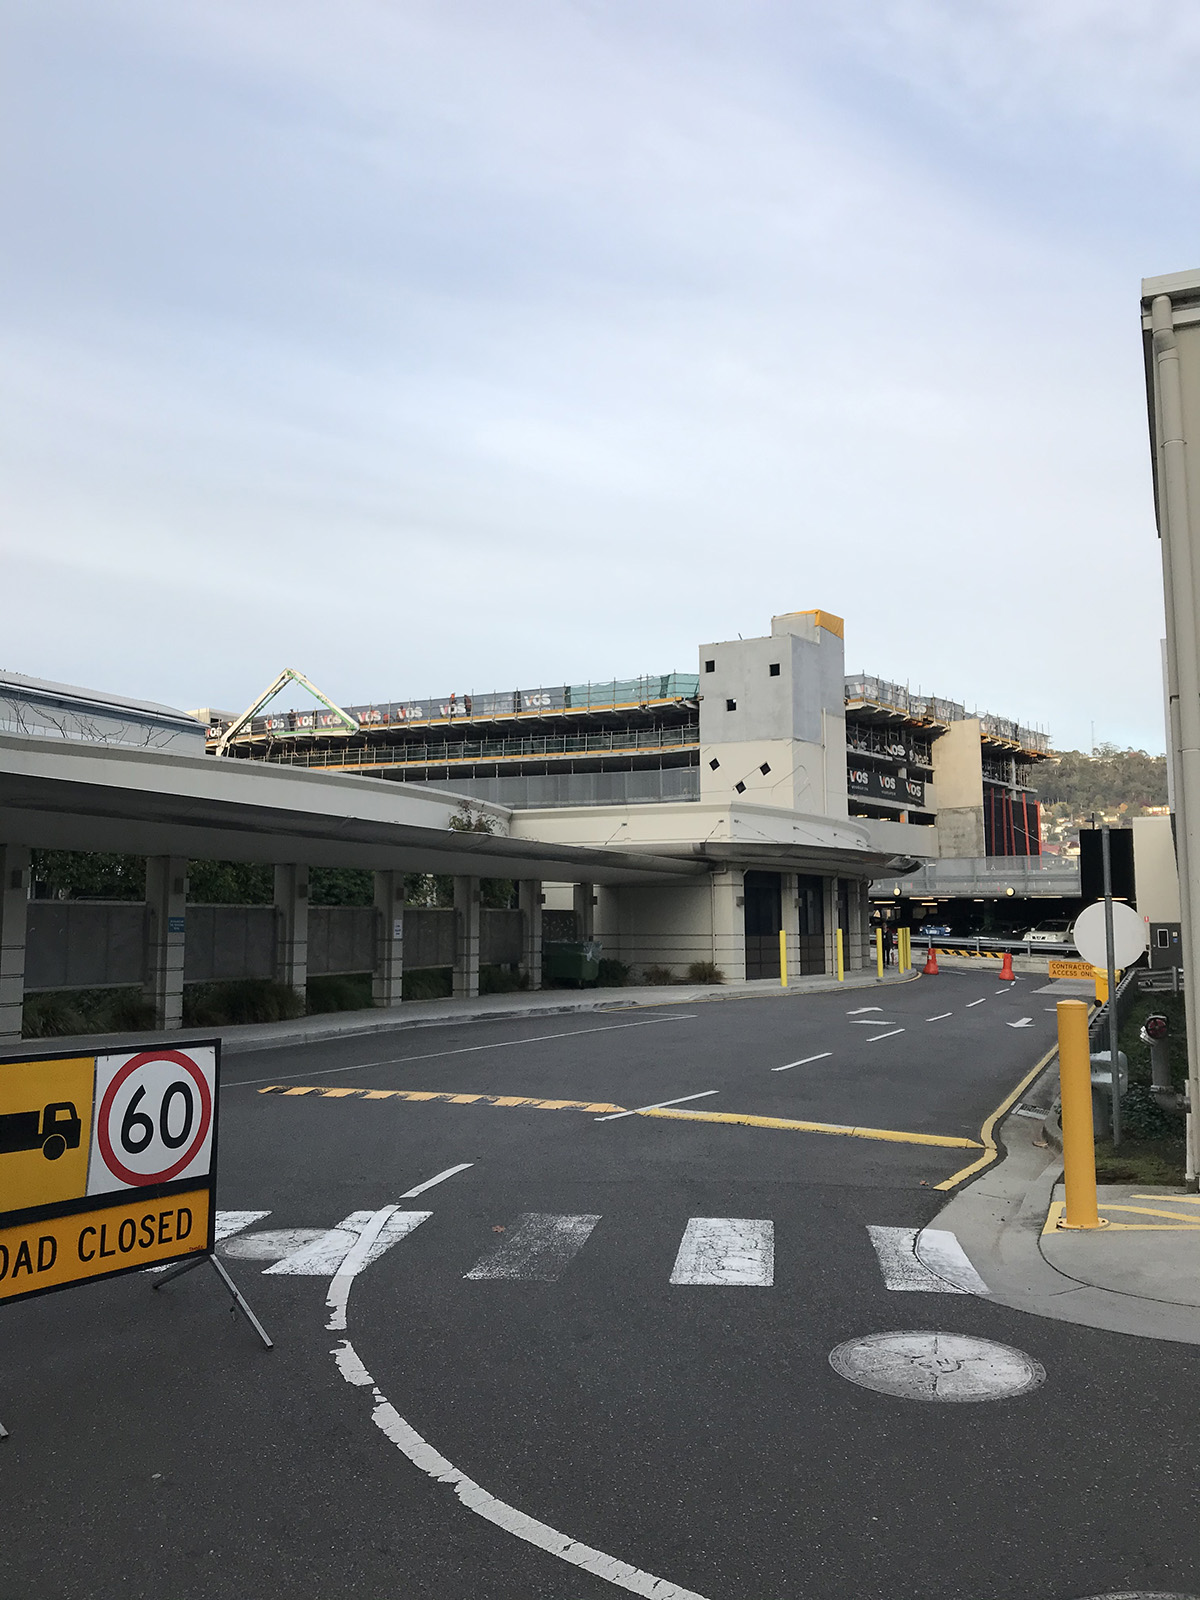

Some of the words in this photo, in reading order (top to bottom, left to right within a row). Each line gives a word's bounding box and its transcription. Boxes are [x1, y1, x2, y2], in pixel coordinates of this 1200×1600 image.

[523, 693, 551, 706] VOS
[397, 706, 423, 719] VOS
[439, 702, 466, 715] VOS
[357, 710, 381, 723] VOS
[265, 718, 285, 730] VOS
[884, 744, 906, 756] VOS
[849, 769, 869, 785] VOS
[879, 775, 896, 790] VOS
[905, 781, 922, 797] VOS
[120, 1081, 194, 1154] 60
[78, 1207, 193, 1263] CLOSED
